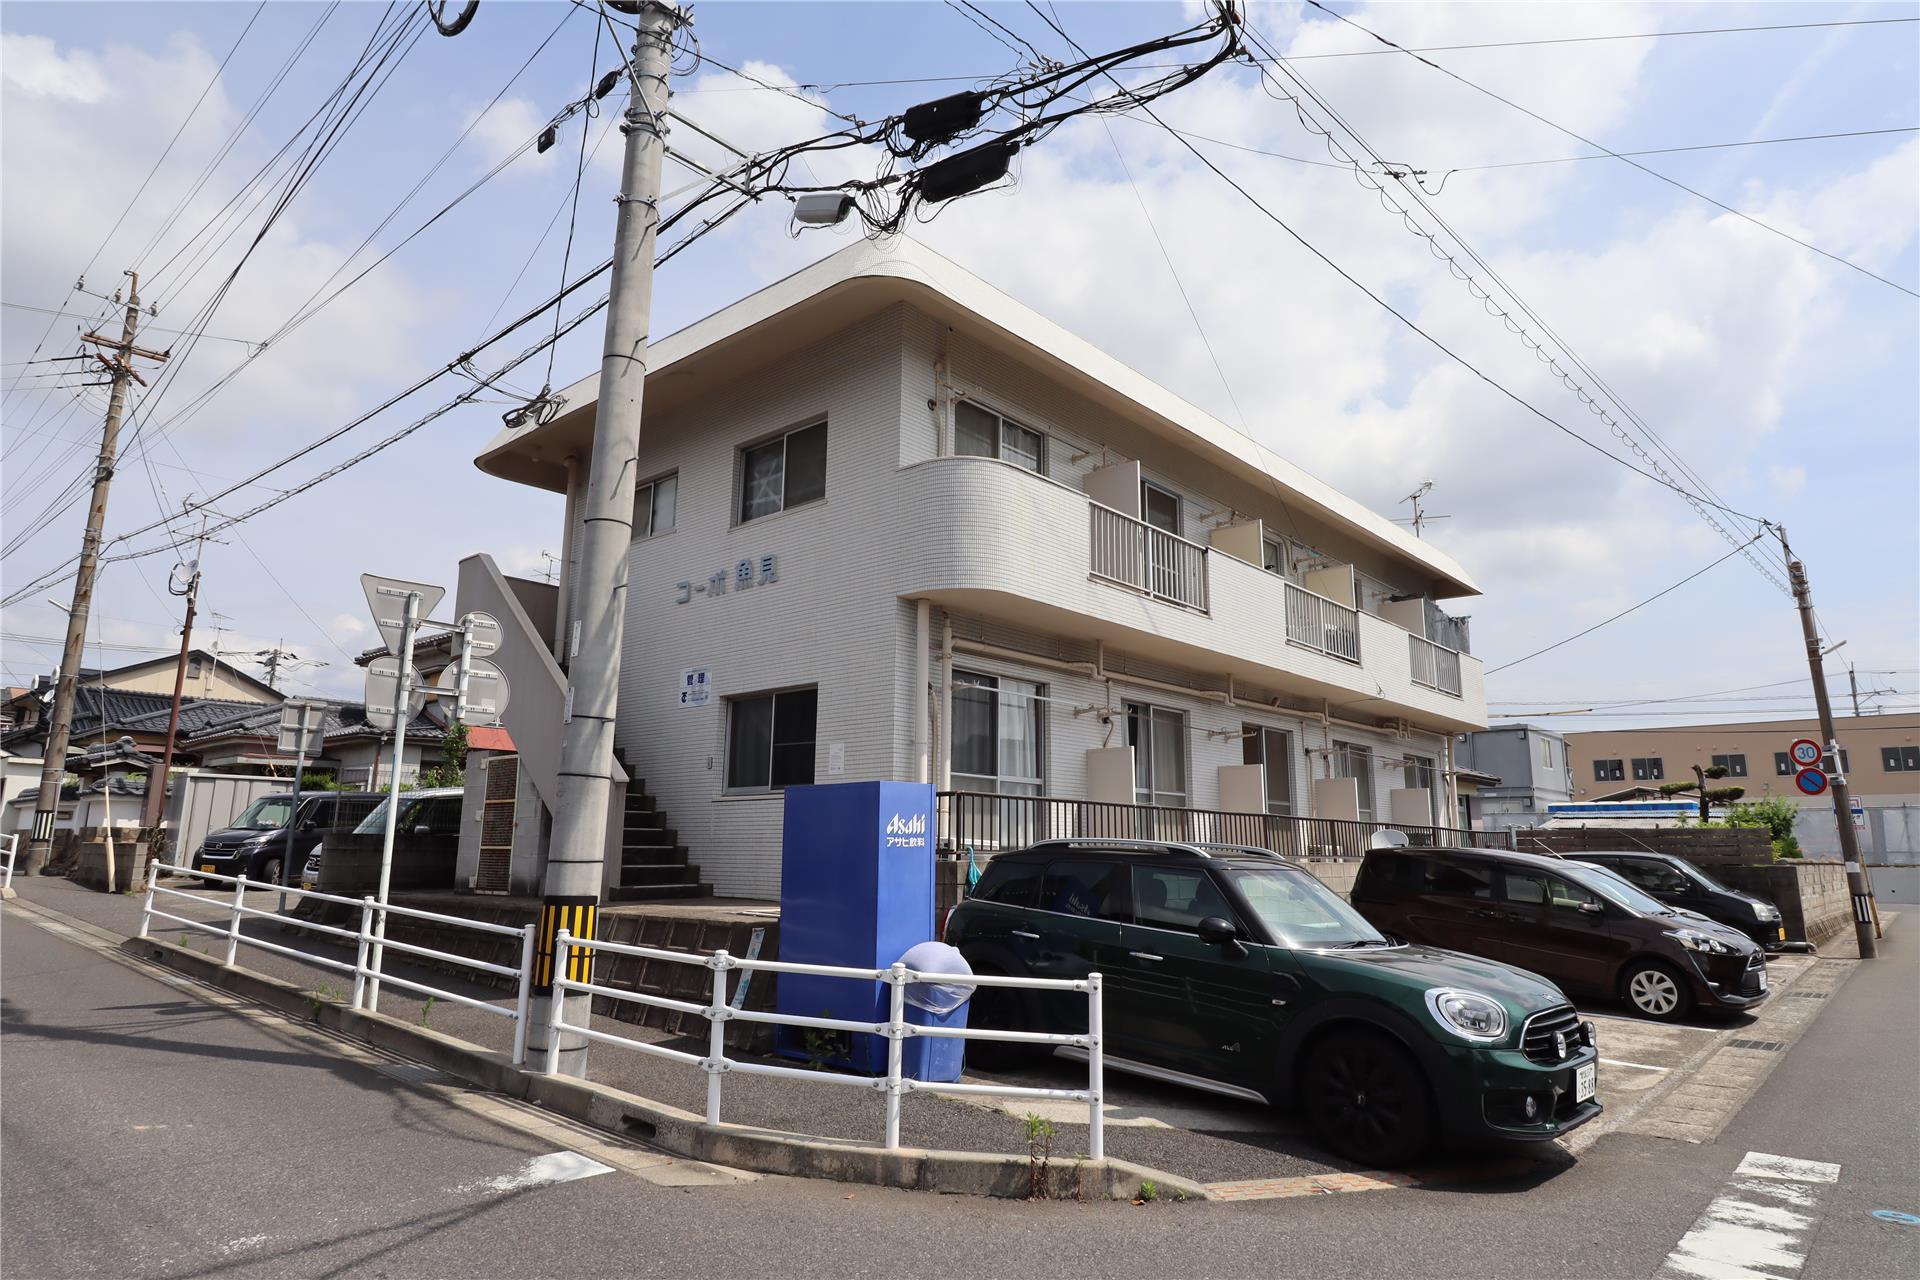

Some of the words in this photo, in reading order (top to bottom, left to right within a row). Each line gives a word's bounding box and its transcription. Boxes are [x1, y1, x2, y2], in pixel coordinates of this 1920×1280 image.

[1796, 746, 1816, 760] 30
[886, 812, 926, 835] Asahi
[886, 837, 925, 848] アサヒ飲料
